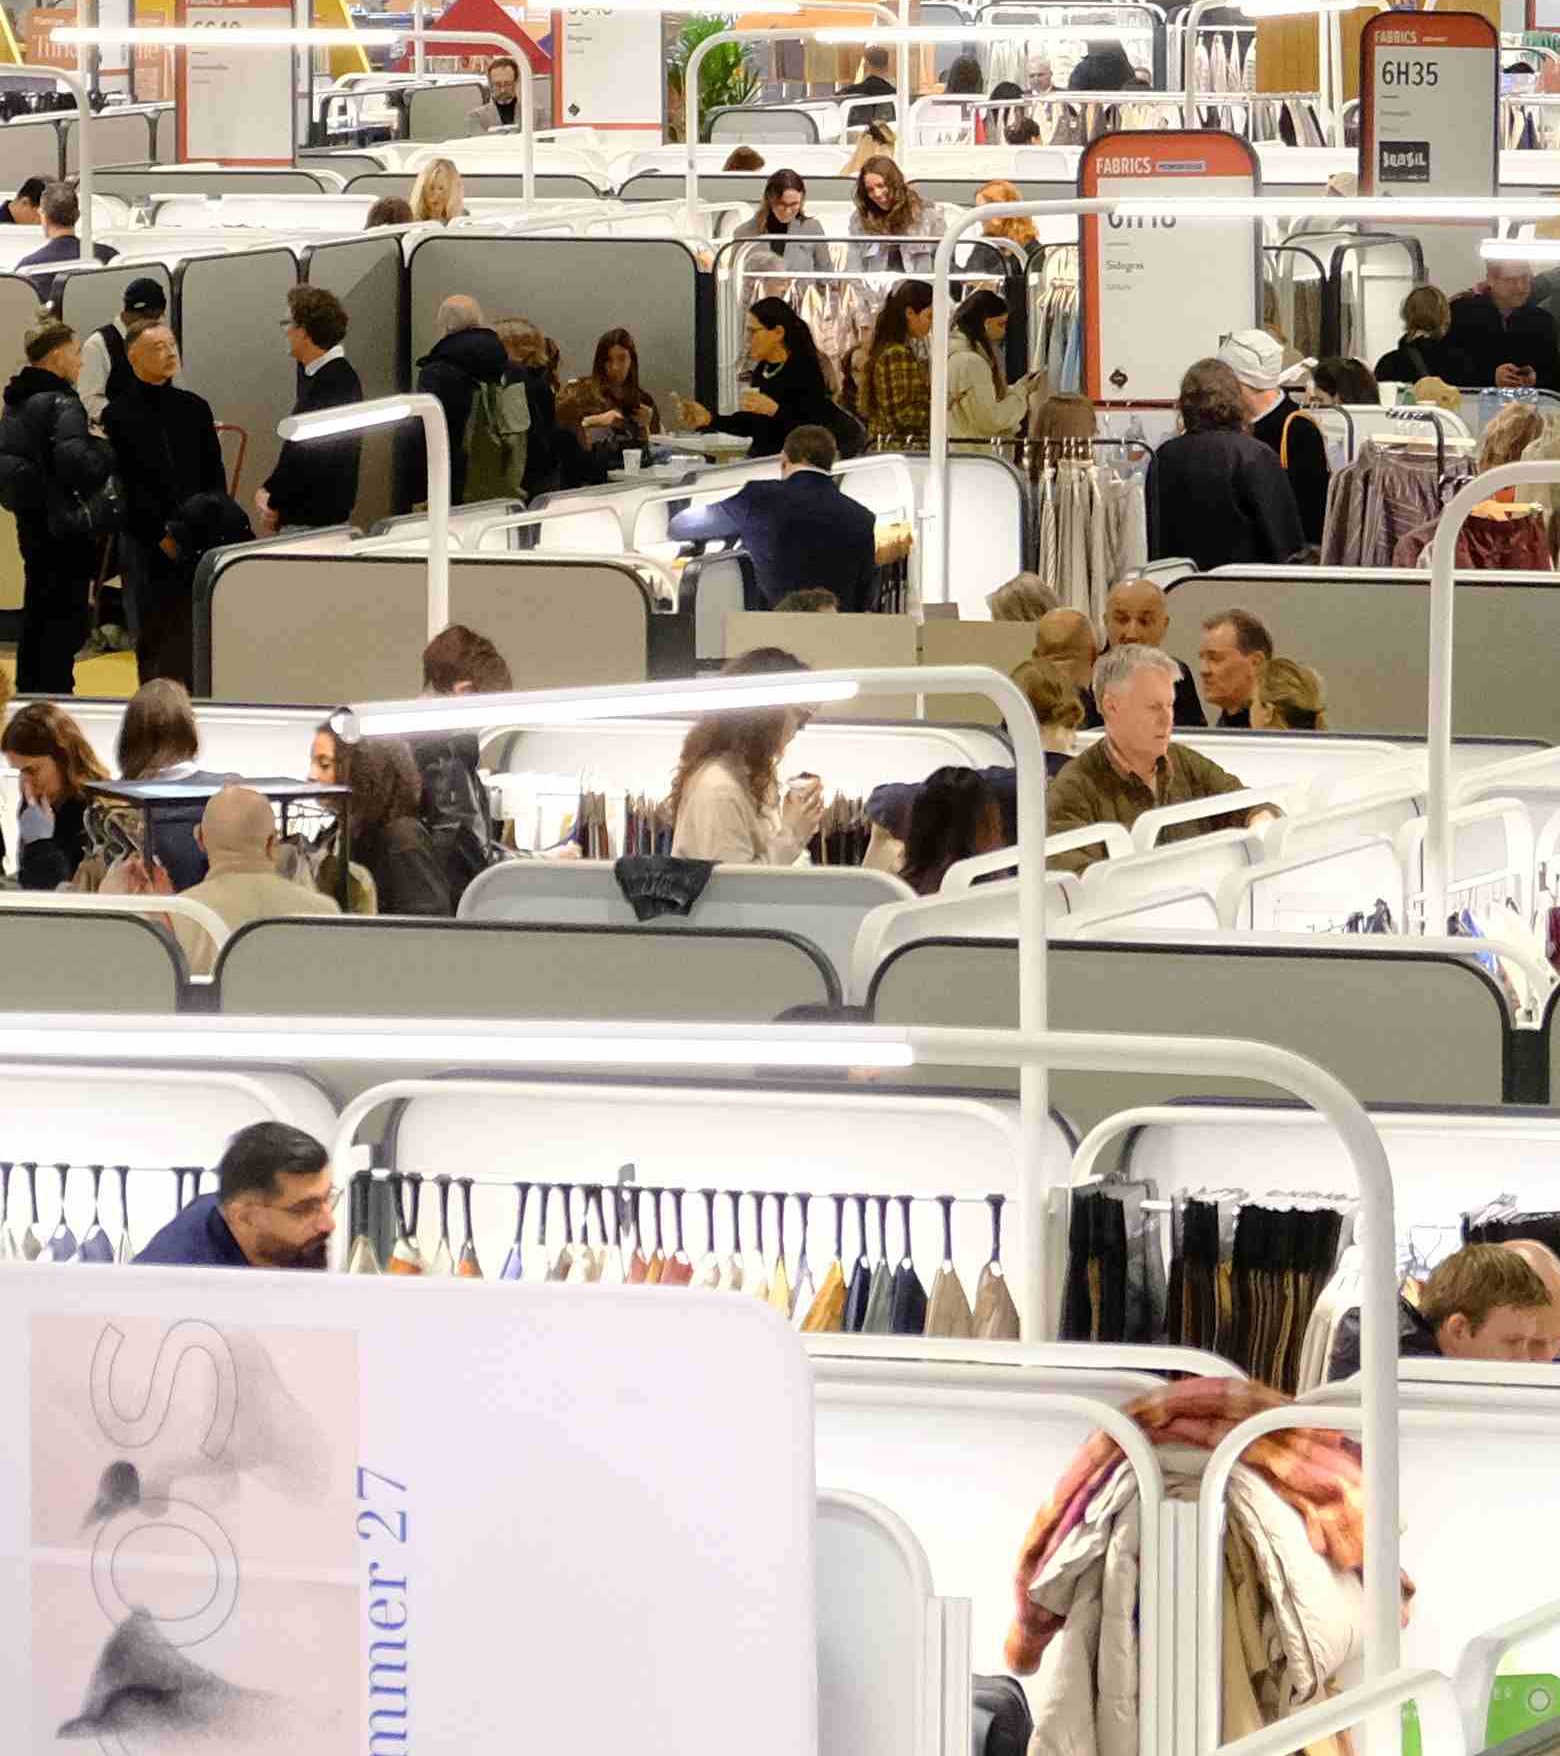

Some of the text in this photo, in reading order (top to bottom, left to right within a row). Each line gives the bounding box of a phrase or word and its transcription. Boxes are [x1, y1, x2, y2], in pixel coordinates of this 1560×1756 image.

[1374, 30, 1417, 45] FABRICS
[1381, 60, 1439, 86] 6H35
[1095, 156, 1152, 175] FABRICS
[355, 1465, 409, 1545] 27
